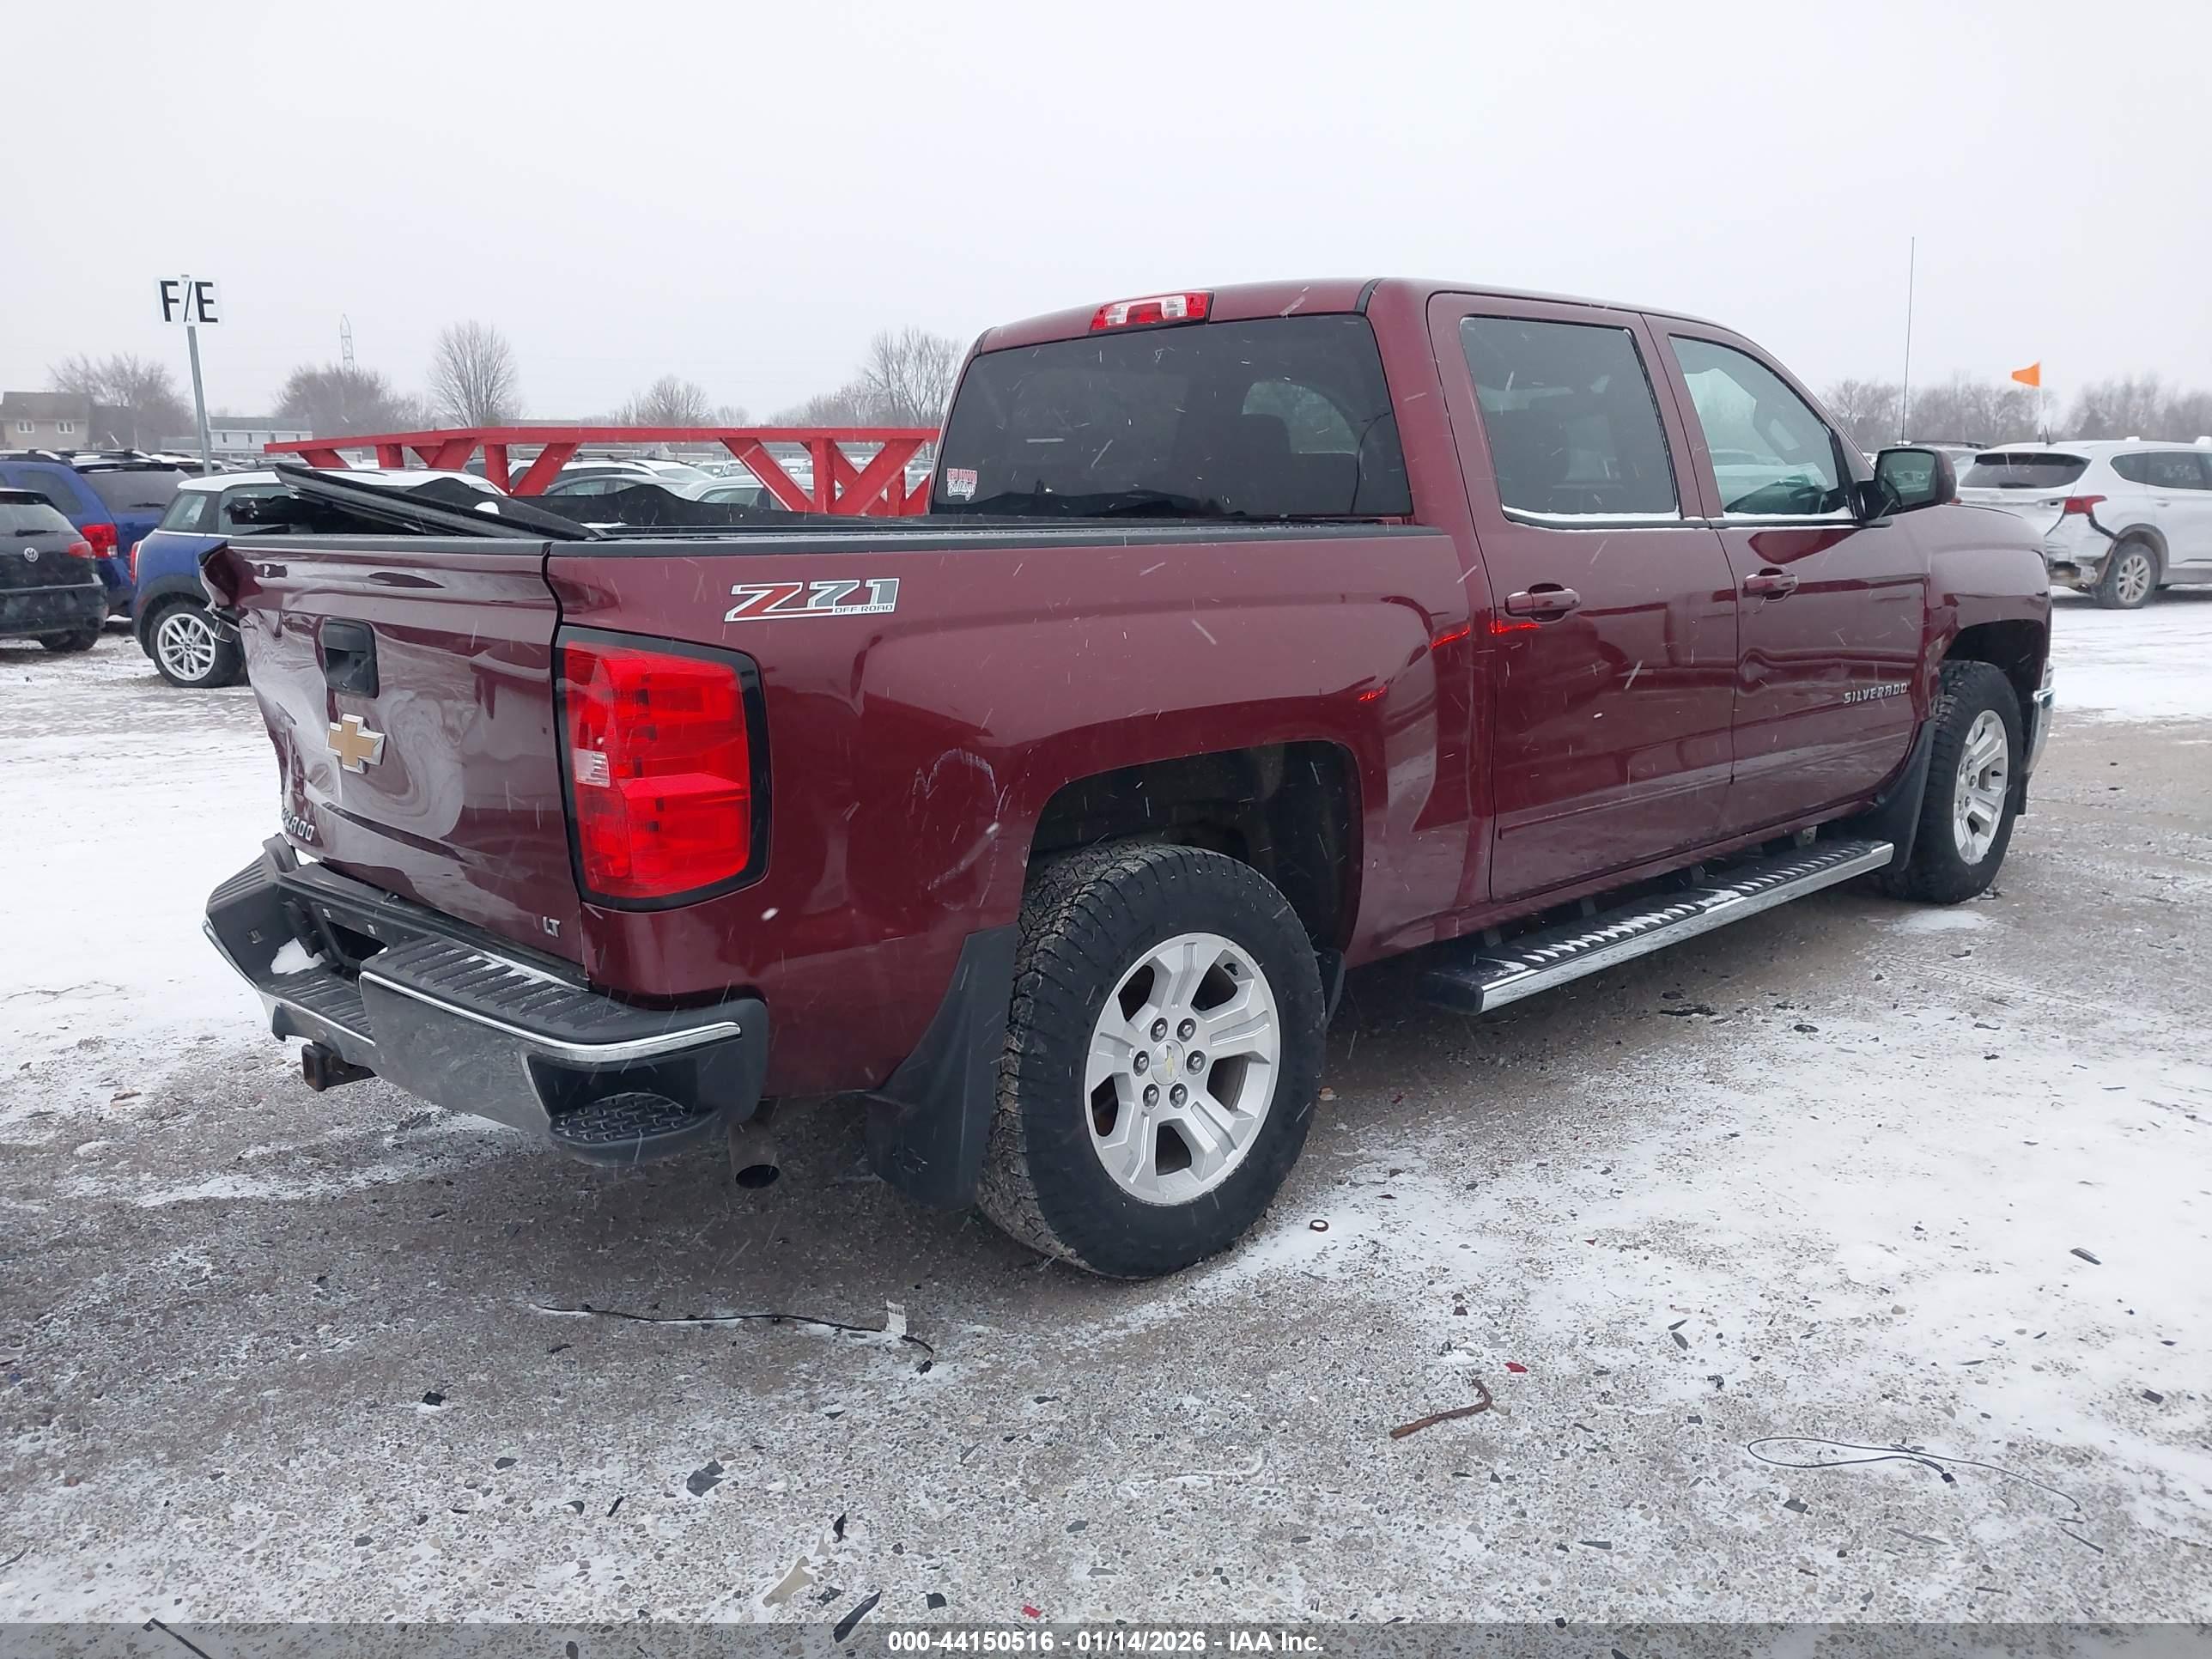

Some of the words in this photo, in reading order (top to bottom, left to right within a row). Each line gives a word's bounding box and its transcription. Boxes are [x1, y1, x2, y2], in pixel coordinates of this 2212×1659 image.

[160, 280, 218, 323] F/E
[724, 578, 900, 623] Z71
[835, 605, 859, 614] OFF
[1844, 683, 1907, 704] SILVERADO
[543, 916, 560, 937] LT
